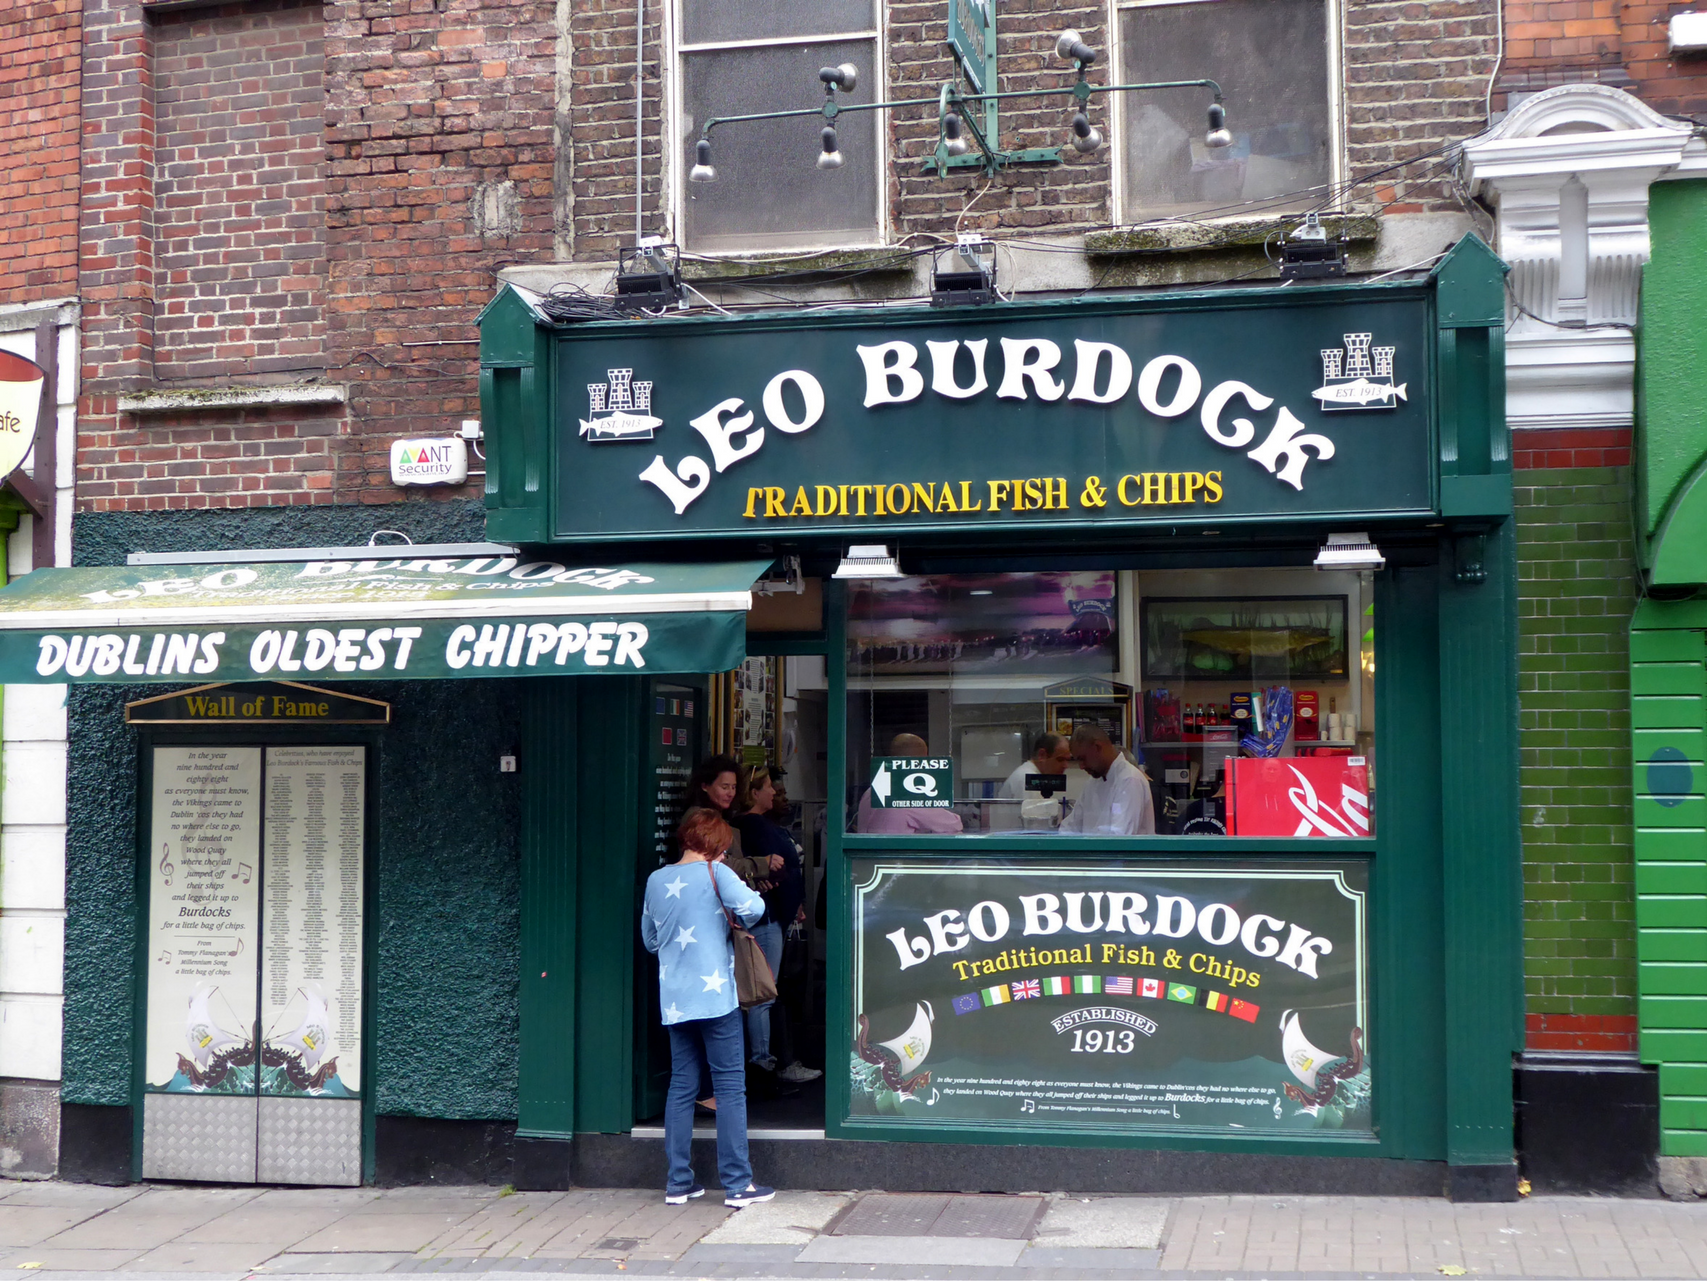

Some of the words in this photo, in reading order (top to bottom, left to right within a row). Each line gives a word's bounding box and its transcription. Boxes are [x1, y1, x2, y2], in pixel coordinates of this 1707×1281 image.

[1336, 389, 1355, 397] EST.
[1360, 388, 1381, 396] 1913
[600, 420, 618, 429] EST.
[621, 419, 641, 428] 1913
[639, 370, 825, 515] LEO
[856, 338, 1336, 491] BURDOCK
[399, 445, 452, 464] AVANT
[742, 480, 982, 518] TRADITIONAL
[987, 477, 1070, 512] FISH
[1080, 475, 1107, 508] &
[1117, 470, 1224, 505] CHIPS
[80, 568, 258, 603] LEO
[466, 579, 556, 591] Chips
[36, 631, 227, 677] DUBLINS
[249, 626, 422, 673] OLDEST
[445, 621, 650, 669] CHIPPER
[1060, 687, 1114, 695] SPECIALS
[185, 696, 235, 717] Wall
[242, 696, 265, 717] of
[272, 696, 329, 717] Fame
[892, 759, 949, 770] PLEASE
[186, 776, 208, 784] eighty
[210, 776, 228, 784] eight
[903, 772, 938, 797] Q
[175, 788, 207, 796] everyone
[186, 799, 212, 808] Vikings
[892, 800, 910, 808] OTHER
[911, 800, 924, 808] SIDE
[925, 800, 932, 808] OF
[934, 800, 949, 808] DOOR
[212, 811, 228, 819] they
[230, 824, 241, 832] go,
[180, 835, 196, 843] they
[207, 847, 227, 855] Quay
[184, 870, 212, 878] jumped
[215, 870, 226, 879] off
[205, 882, 224, 890] ships
[188, 894, 210, 903] legged
[179, 906, 231, 917] Burdocks
[160, 921, 174, 930] for
[201, 922, 214, 931] bag
[216, 922, 225, 930] of
[225, 922, 245, 930] chips.
[886, 900, 1010, 971] LEO
[1018, 890, 1333, 980] BURDOCK
[953, 944, 1093, 982] Traditional
[1102, 943, 1156, 967] Fish
[1162, 948, 1183, 969] &
[1188, 953, 1262, 989] Chips
[1052, 1008, 1156, 1034] ESTABLISHED
[1070, 1029, 1135, 1053] 1913
[1123, 1082, 1142, 1090] Vikings
[1165, 1093, 1206, 1103] Burdocks
